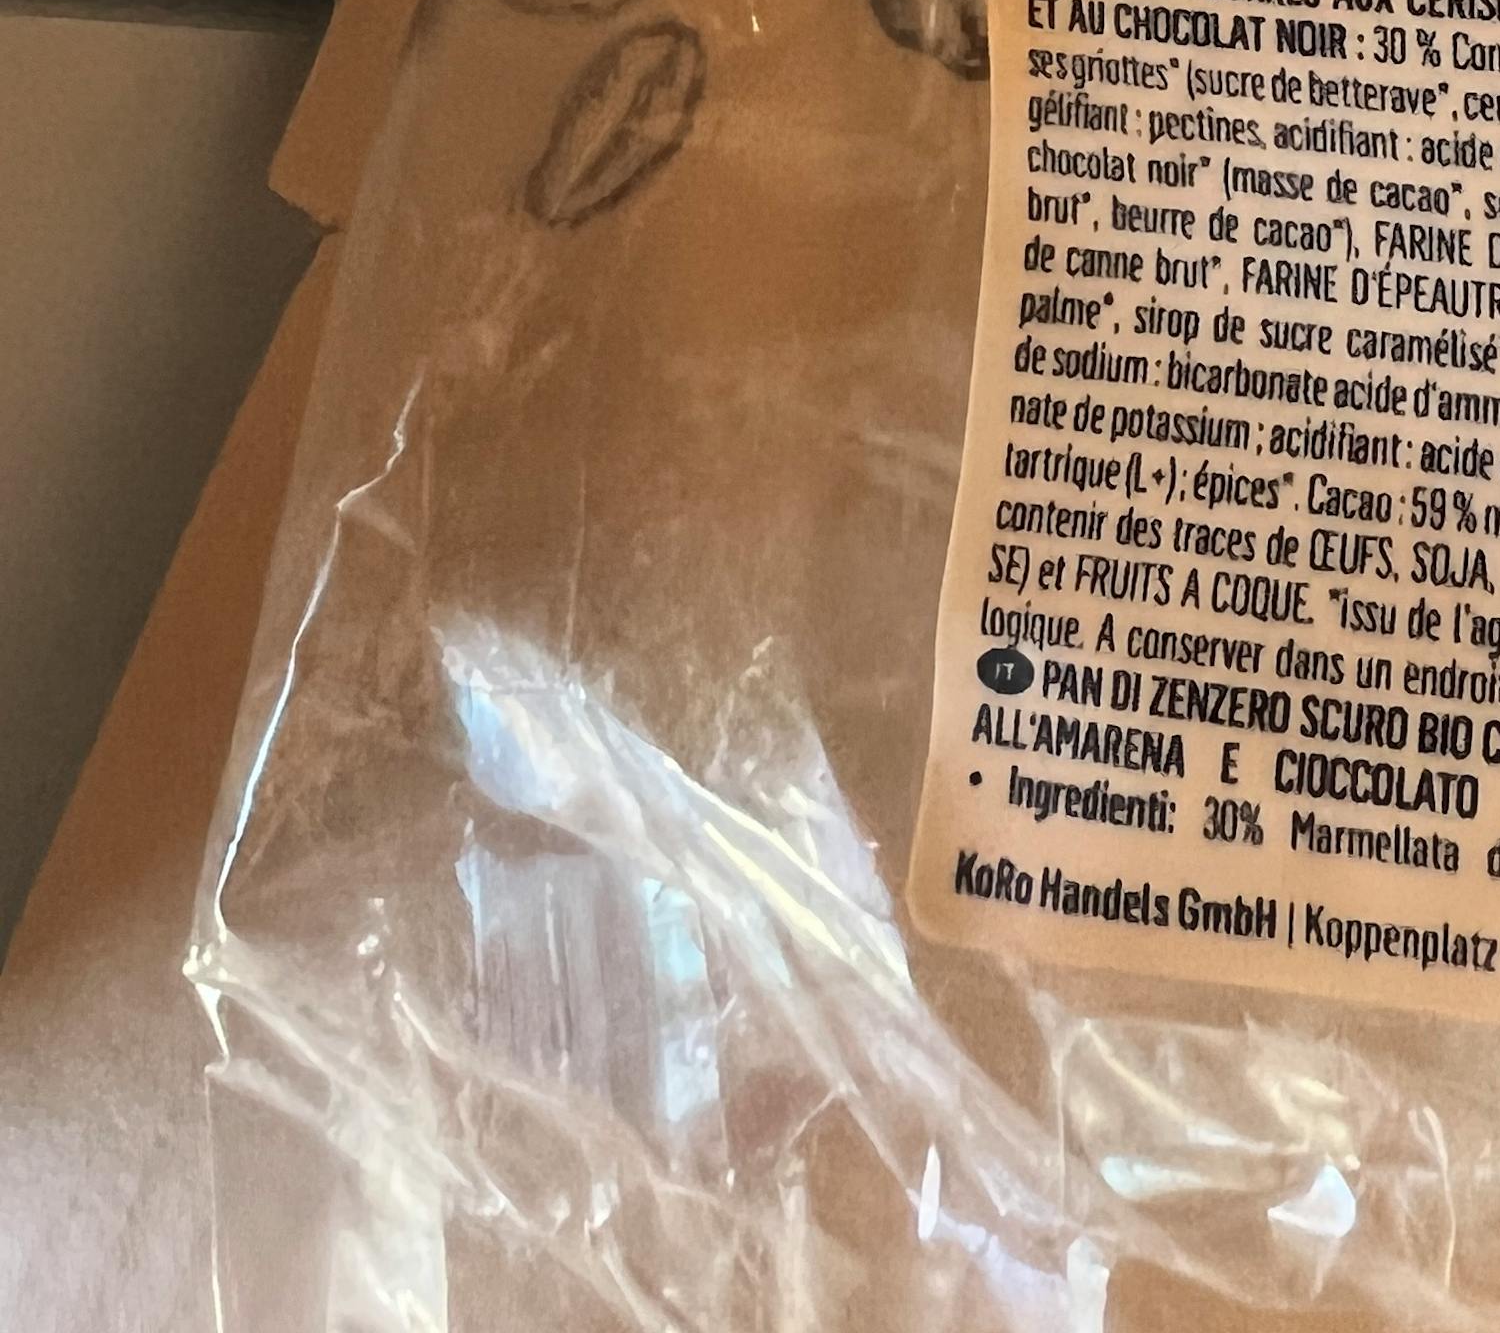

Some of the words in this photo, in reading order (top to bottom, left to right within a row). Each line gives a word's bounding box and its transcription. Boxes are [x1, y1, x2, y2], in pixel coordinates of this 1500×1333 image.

[1042, 658, 1104, 708] PAN
[1109, 669, 1142, 713] DI
[1148, 674, 1292, 735] ZENZERO
[1299, 693, 1410, 751] SCURO
[1417, 711, 1474, 761] BIO
[1220, 741, 1241, 786] E
[1274, 747, 1479, 820] CIOCCOLATO
[954, 849, 1034, 906] KoRo
[1038, 866, 1171, 927] Handels
[1177, 886, 1277, 940] GmbH
[1305, 902, 1498, 973] Koppenplatz
